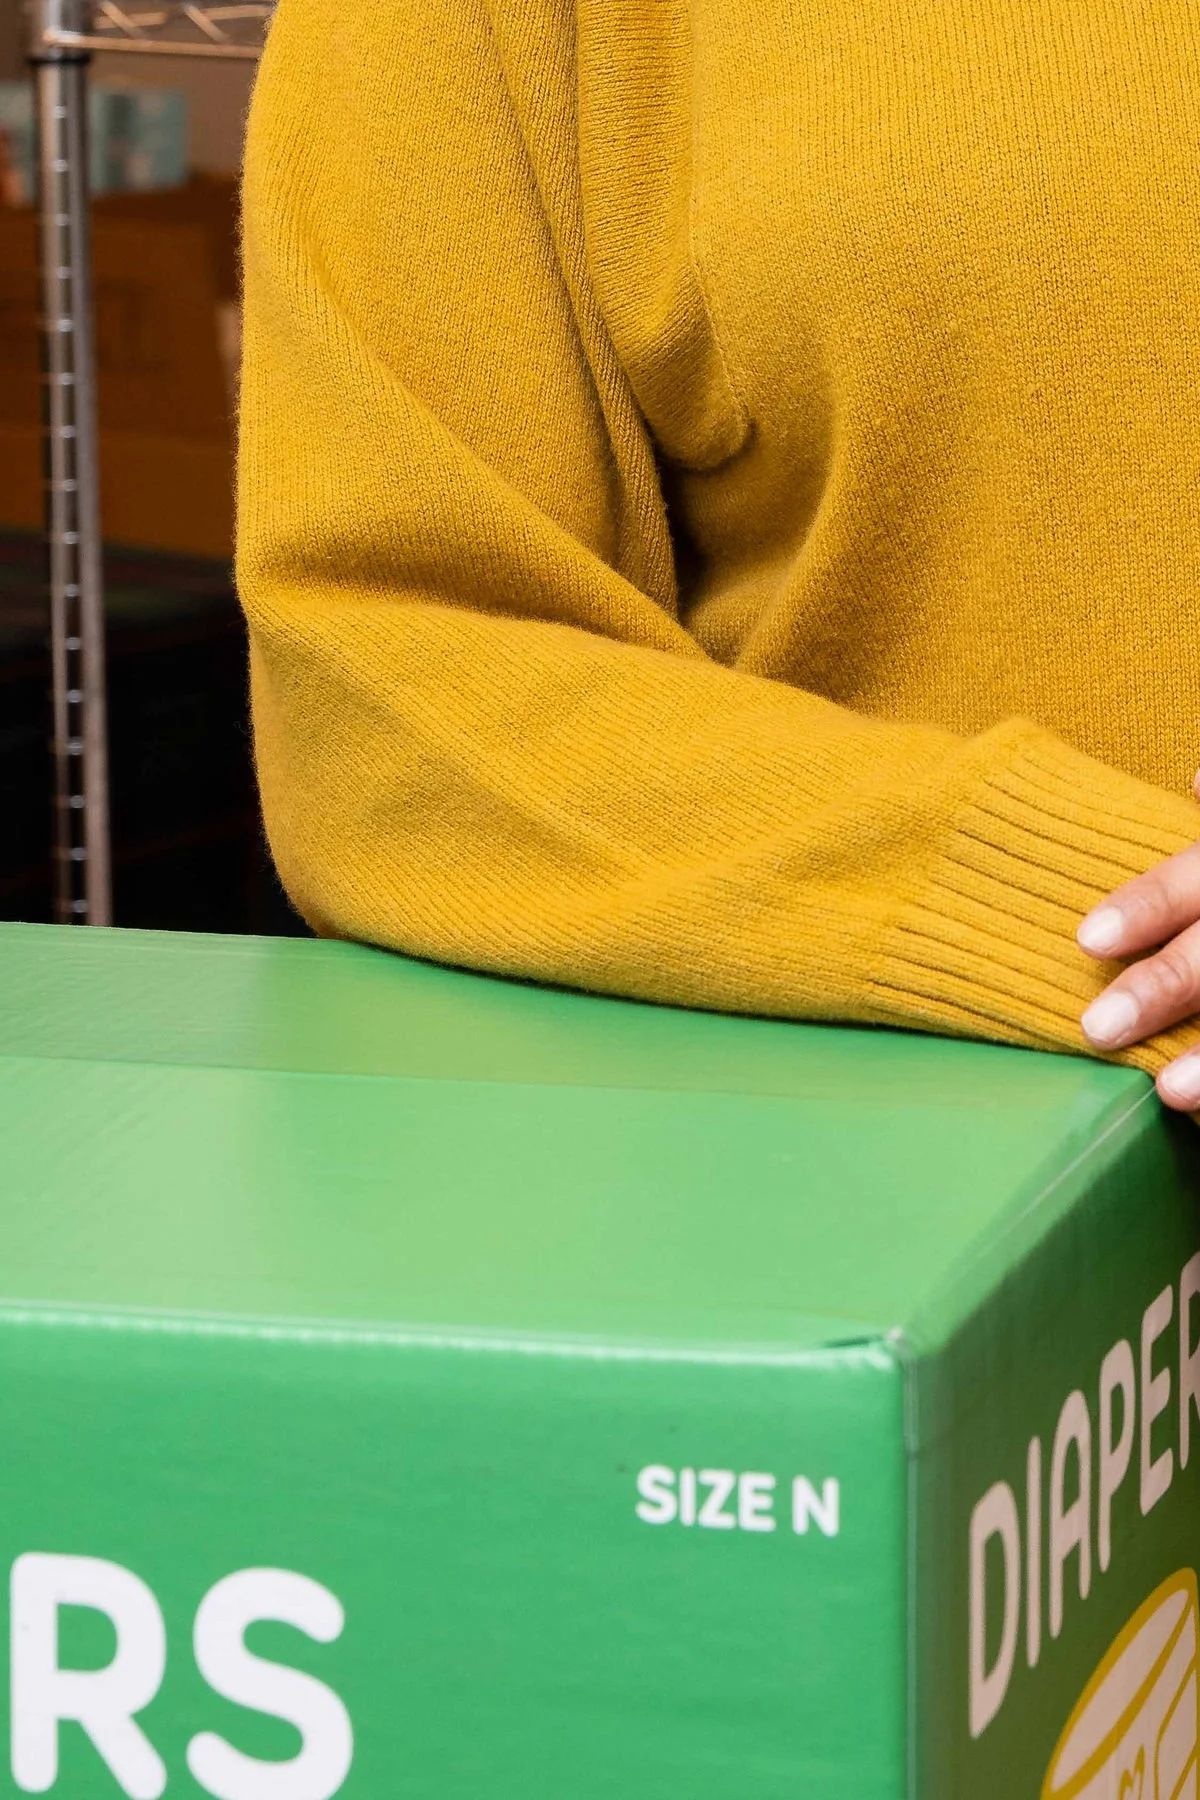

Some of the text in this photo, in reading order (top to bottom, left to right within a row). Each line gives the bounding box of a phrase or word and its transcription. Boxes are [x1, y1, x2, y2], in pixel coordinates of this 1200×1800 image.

[635, 1464, 839, 1537] SIZE N
[10, 1551, 354, 1800] RS
